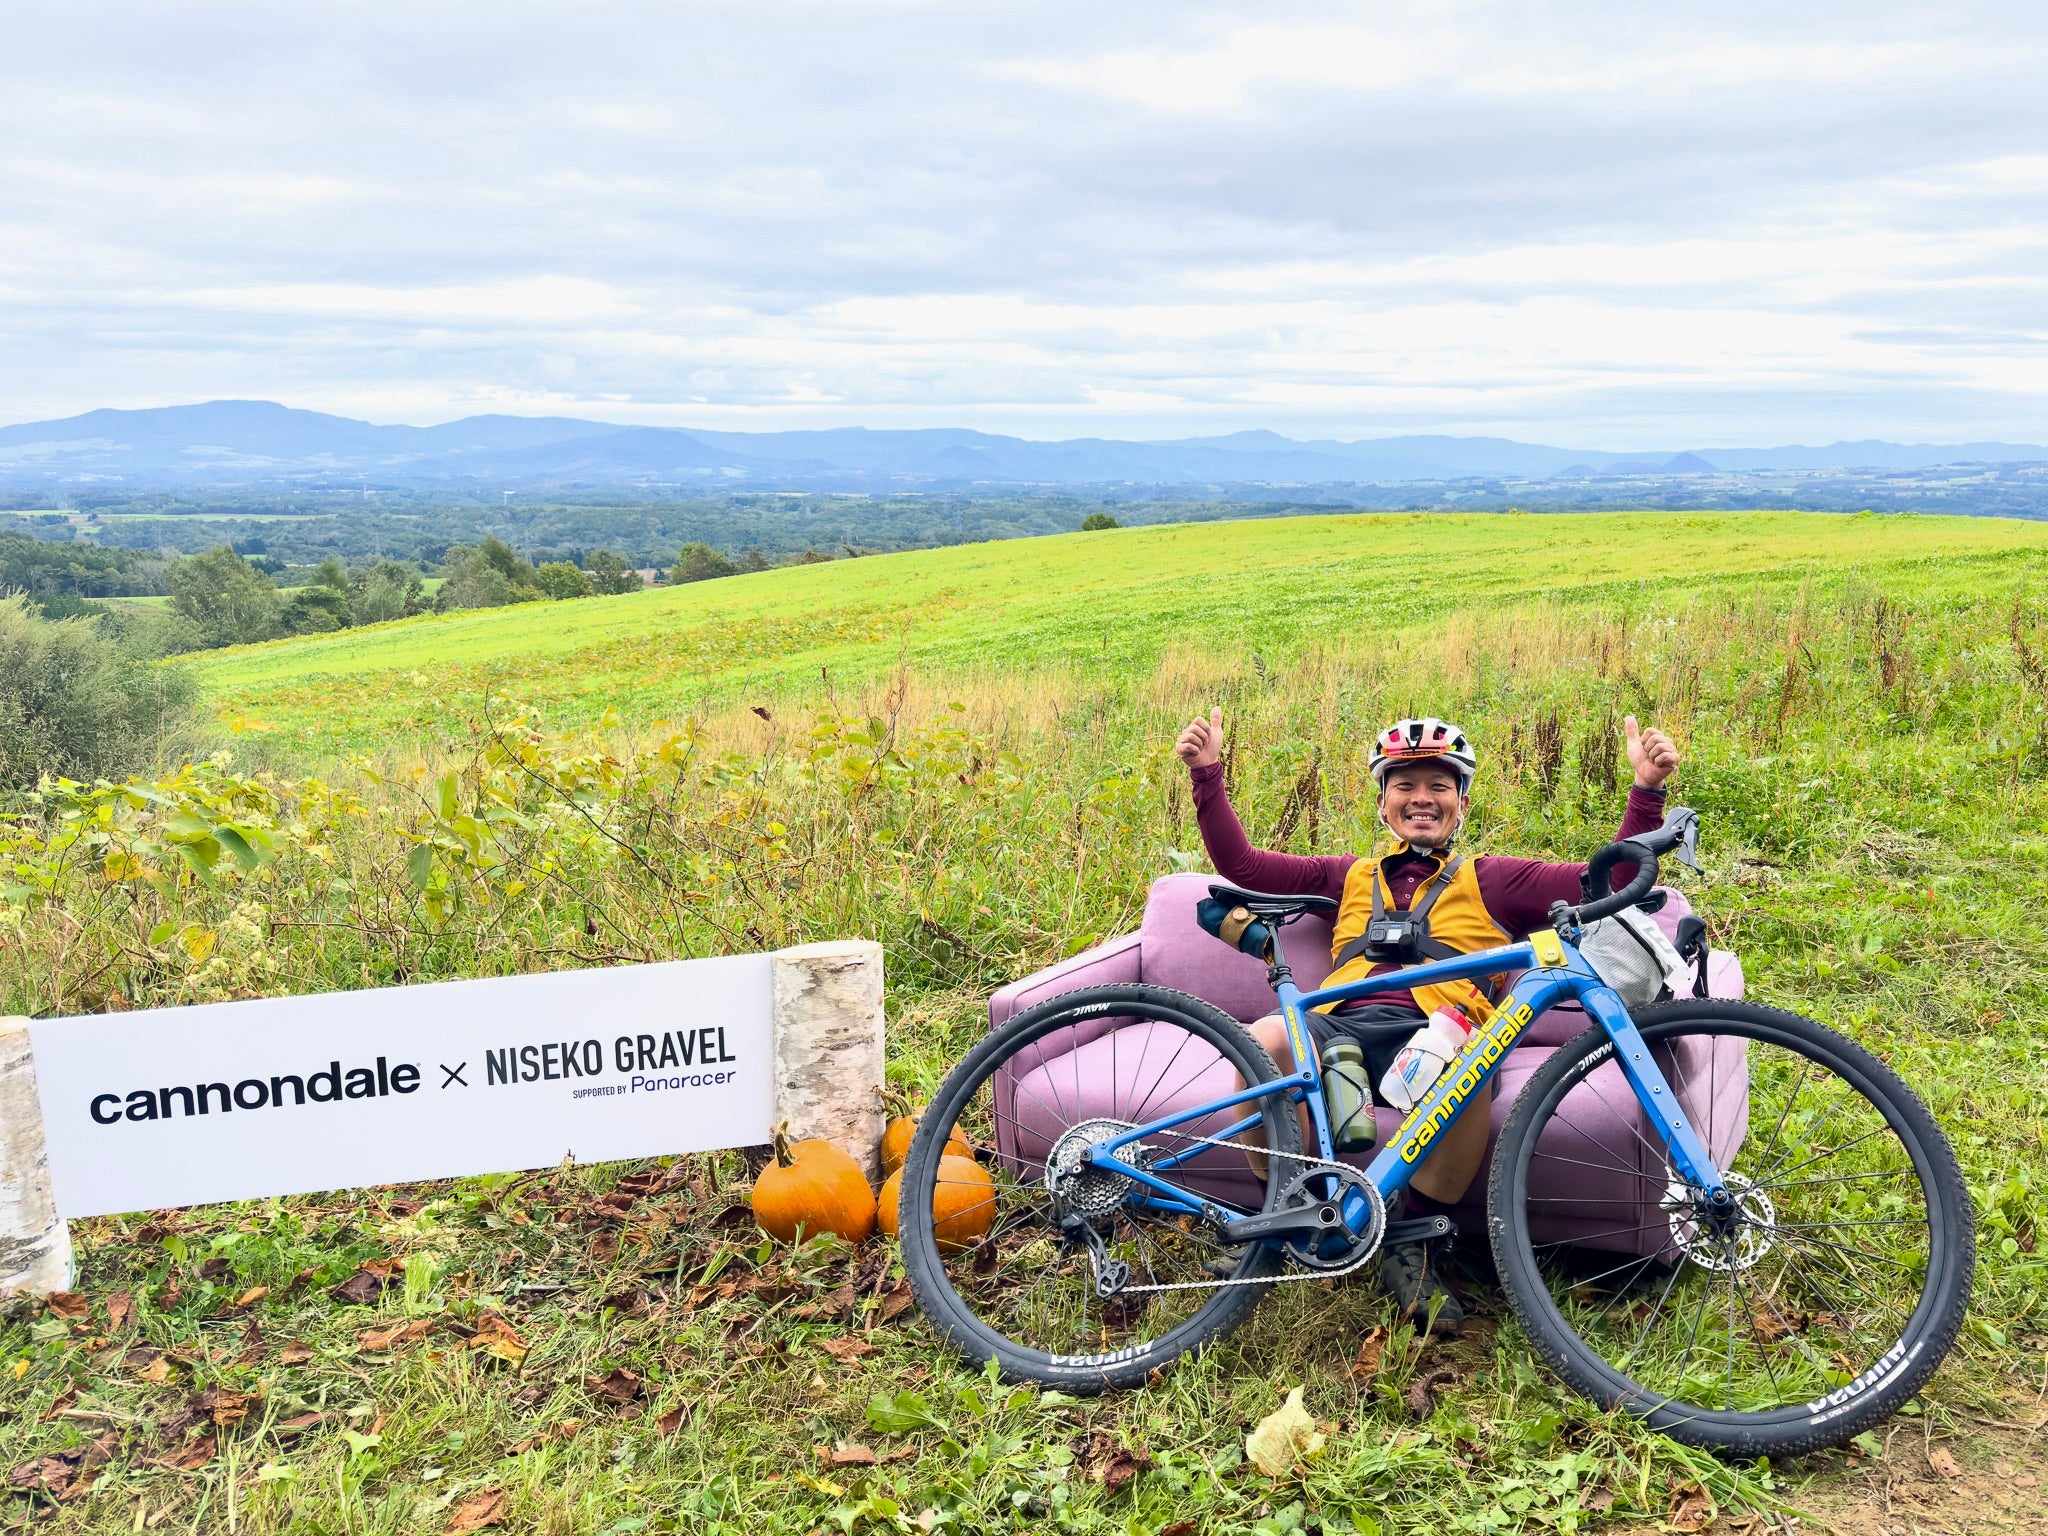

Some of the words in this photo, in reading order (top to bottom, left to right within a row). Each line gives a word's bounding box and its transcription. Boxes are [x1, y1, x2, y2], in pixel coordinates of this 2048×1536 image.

[1073, 1002, 1111, 1016] MAVIC
[1578, 1041, 1613, 1071] MAVIC
[90, 1057, 421, 1125] cannondale
[486, 1039, 603, 1086] NISEKO
[615, 1027, 736, 1072] GRAVEL
[573, 1086, 615, 1099] SUPPORTED
[616, 1085, 627, 1095] BY
[631, 1071, 736, 1093] Panaracer
[1400, 1003, 1534, 1164] cannondale
